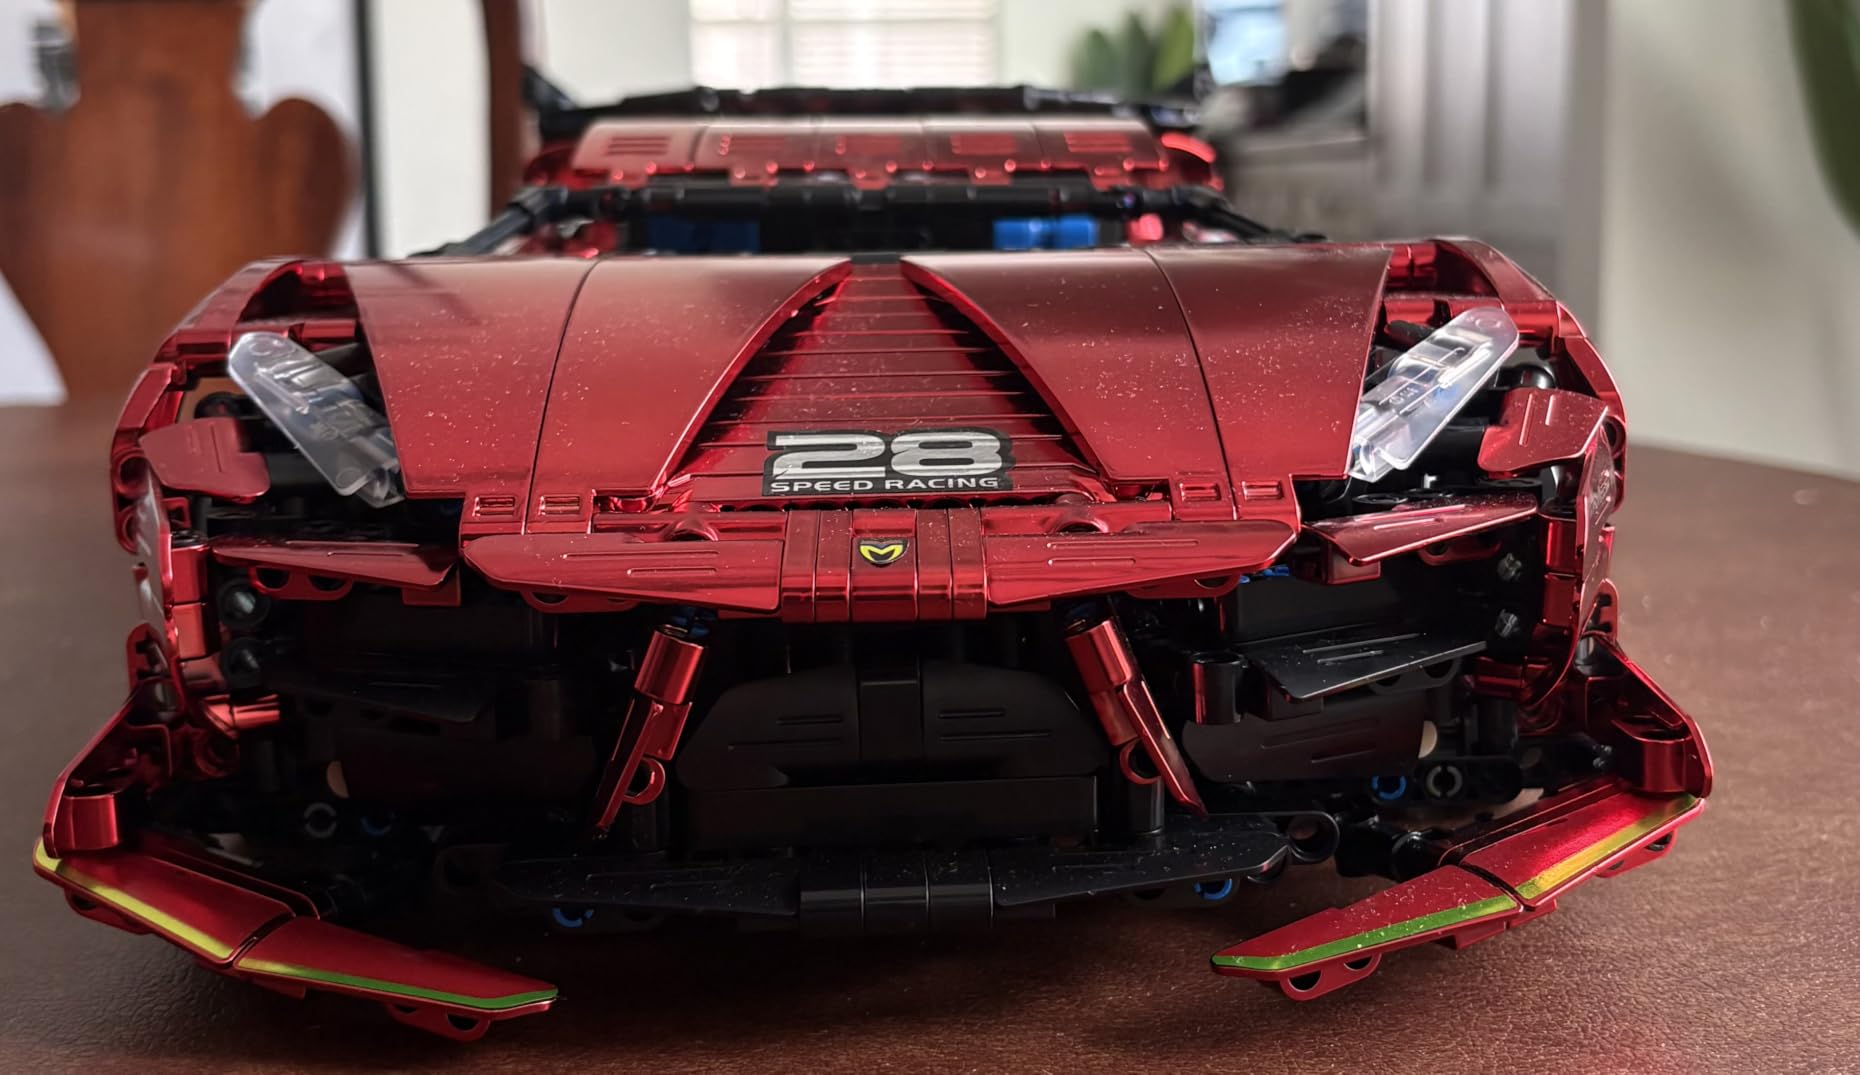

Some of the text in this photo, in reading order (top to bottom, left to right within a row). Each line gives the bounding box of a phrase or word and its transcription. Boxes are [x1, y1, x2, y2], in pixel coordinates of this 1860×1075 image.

[773, 432, 1002, 478] 28
[771, 478, 998, 493] SPEED RACING
